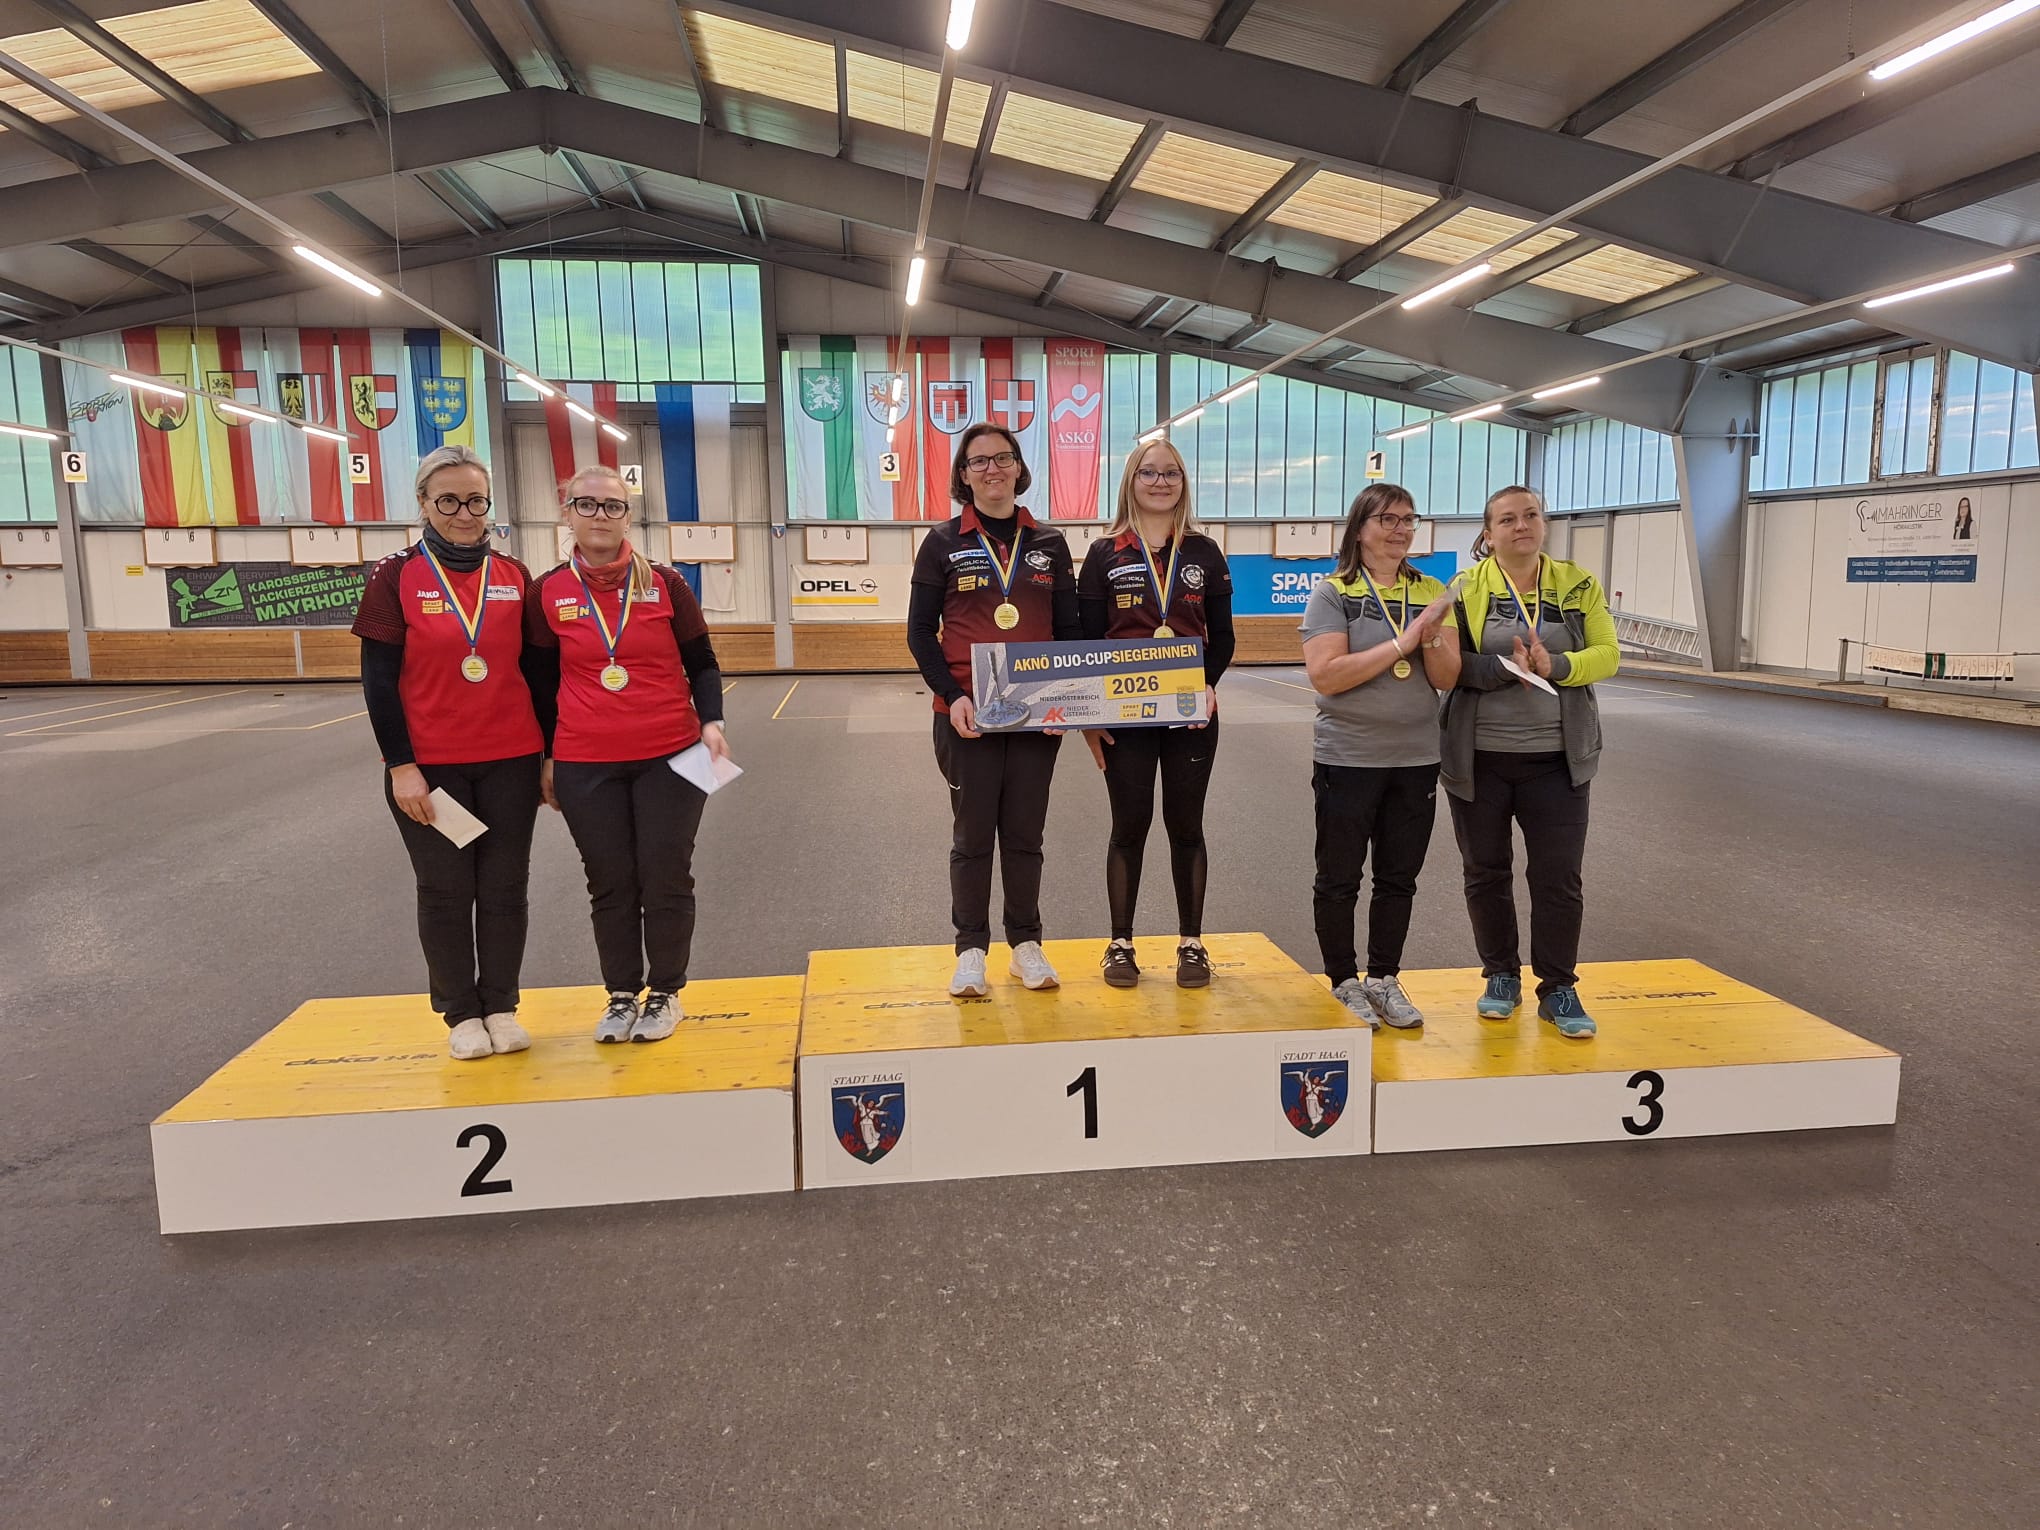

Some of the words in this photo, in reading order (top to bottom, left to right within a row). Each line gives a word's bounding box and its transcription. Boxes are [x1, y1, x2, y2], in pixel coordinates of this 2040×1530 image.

[1055, 347, 1096, 358] SPORT
[1057, 429, 1095, 443] ASKÖ
[66, 453, 81, 473] 6
[352, 455, 365, 474] 5
[884, 454, 895, 473] 3
[1370, 452, 1382, 471] 1
[625, 467, 638, 486] 4
[1878, 502, 1942, 521] MAHRINGER
[248, 569, 331, 593] KAROSSERIE-
[251, 574, 365, 605] LACKIERZENTRUM
[800, 580, 857, 592] OPEL
[416, 590, 440, 599] JAKO
[554, 597, 577, 607] JAKO
[1013, 654, 1050, 672] AKNÖ
[1053, 644, 1197, 671] DUO-CUPSIEGERINNEN
[1112, 675, 1159, 695] 2026
[1040, 694, 1099, 702] NIEDERÖSTERREICH
[1041, 706, 1066, 723] AK
[864, 1000, 952, 1010] doka
[284, 1056, 379, 1067] doka
[1282, 1051, 1316, 1061] STADT
[1318, 1050, 1348, 1060] HAAG
[833, 1075, 869, 1086] STADT
[872, 1072, 903, 1083] HAAG
[1066, 1067, 1099, 1140] 1
[1621, 1069, 1664, 1137] 3
[455, 1123, 514, 1198] 2
